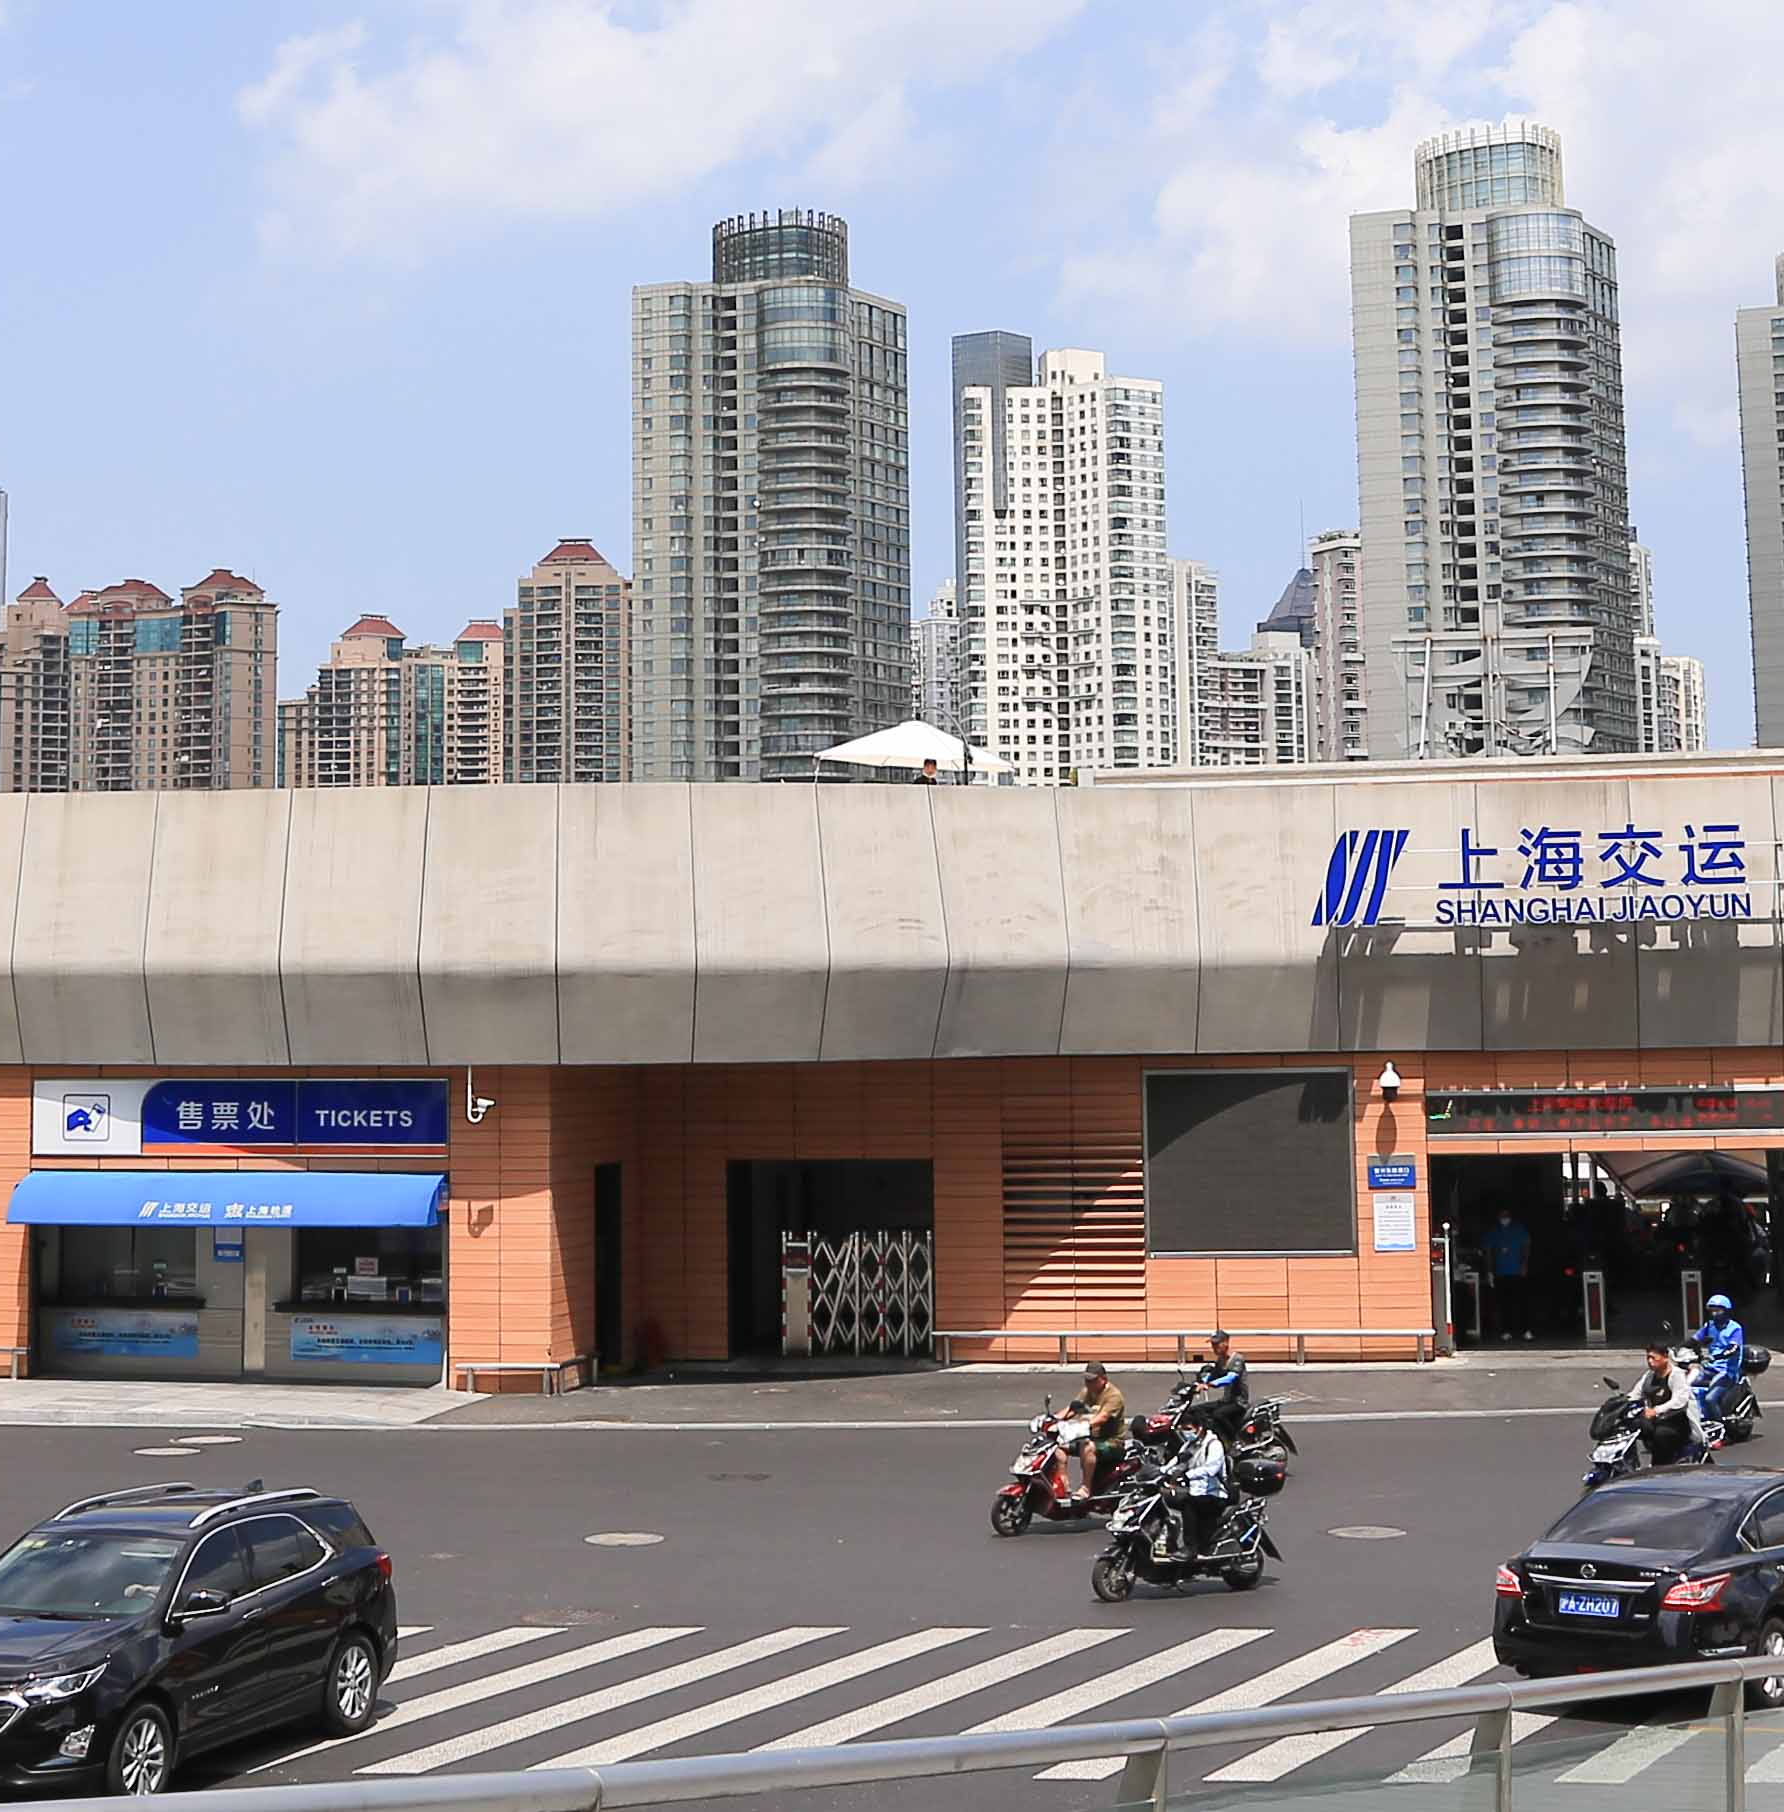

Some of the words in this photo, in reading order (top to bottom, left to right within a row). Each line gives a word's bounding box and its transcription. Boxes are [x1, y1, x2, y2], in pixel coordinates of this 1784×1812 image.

[1439, 824, 1747, 889] 上海交运
[1435, 896, 1605, 924] SHANGHAI
[1611, 893, 1752, 920] JIAOYUN
[176, 1101, 275, 1130] 售票处
[315, 1110, 413, 1127] TICKETS
